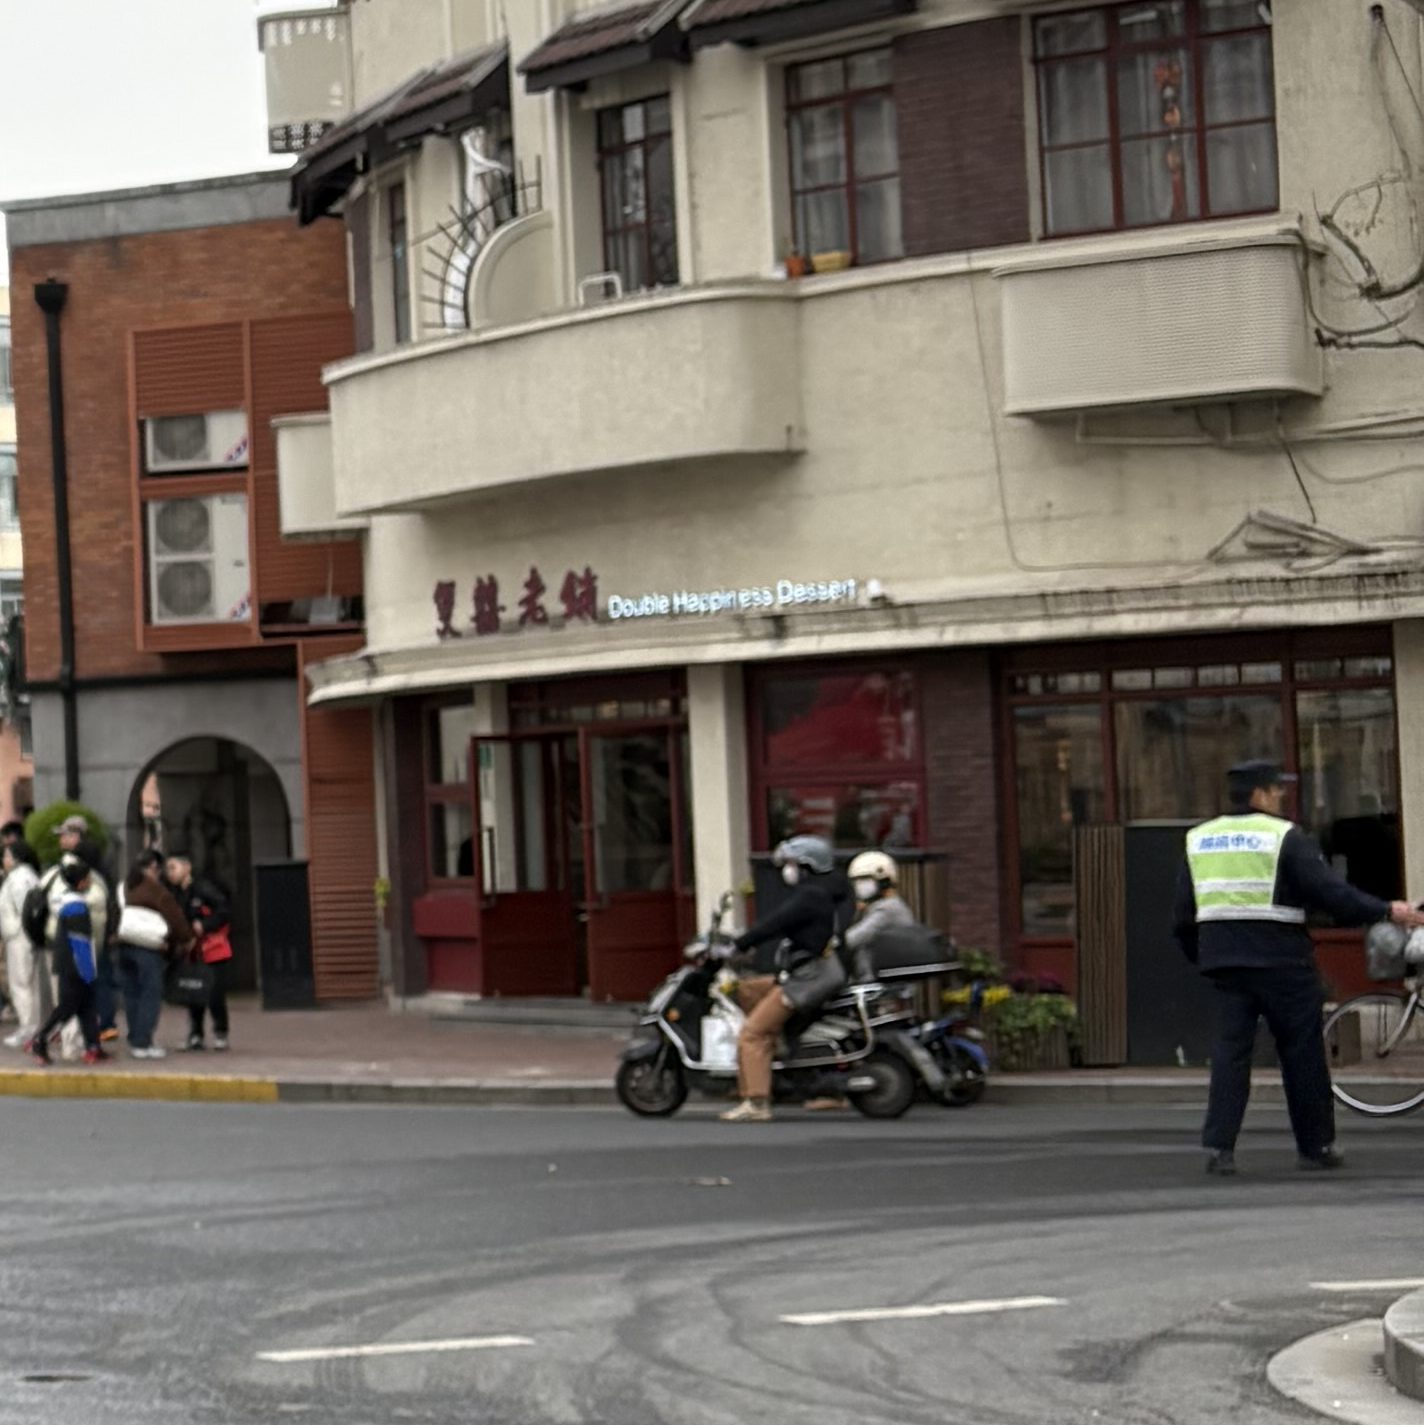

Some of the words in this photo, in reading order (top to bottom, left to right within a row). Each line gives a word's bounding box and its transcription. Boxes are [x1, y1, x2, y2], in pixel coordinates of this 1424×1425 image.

[607, 592, 670, 619] Double
[673, 587, 774, 617] Happiness
[776, 578, 857, 605] Dessert
